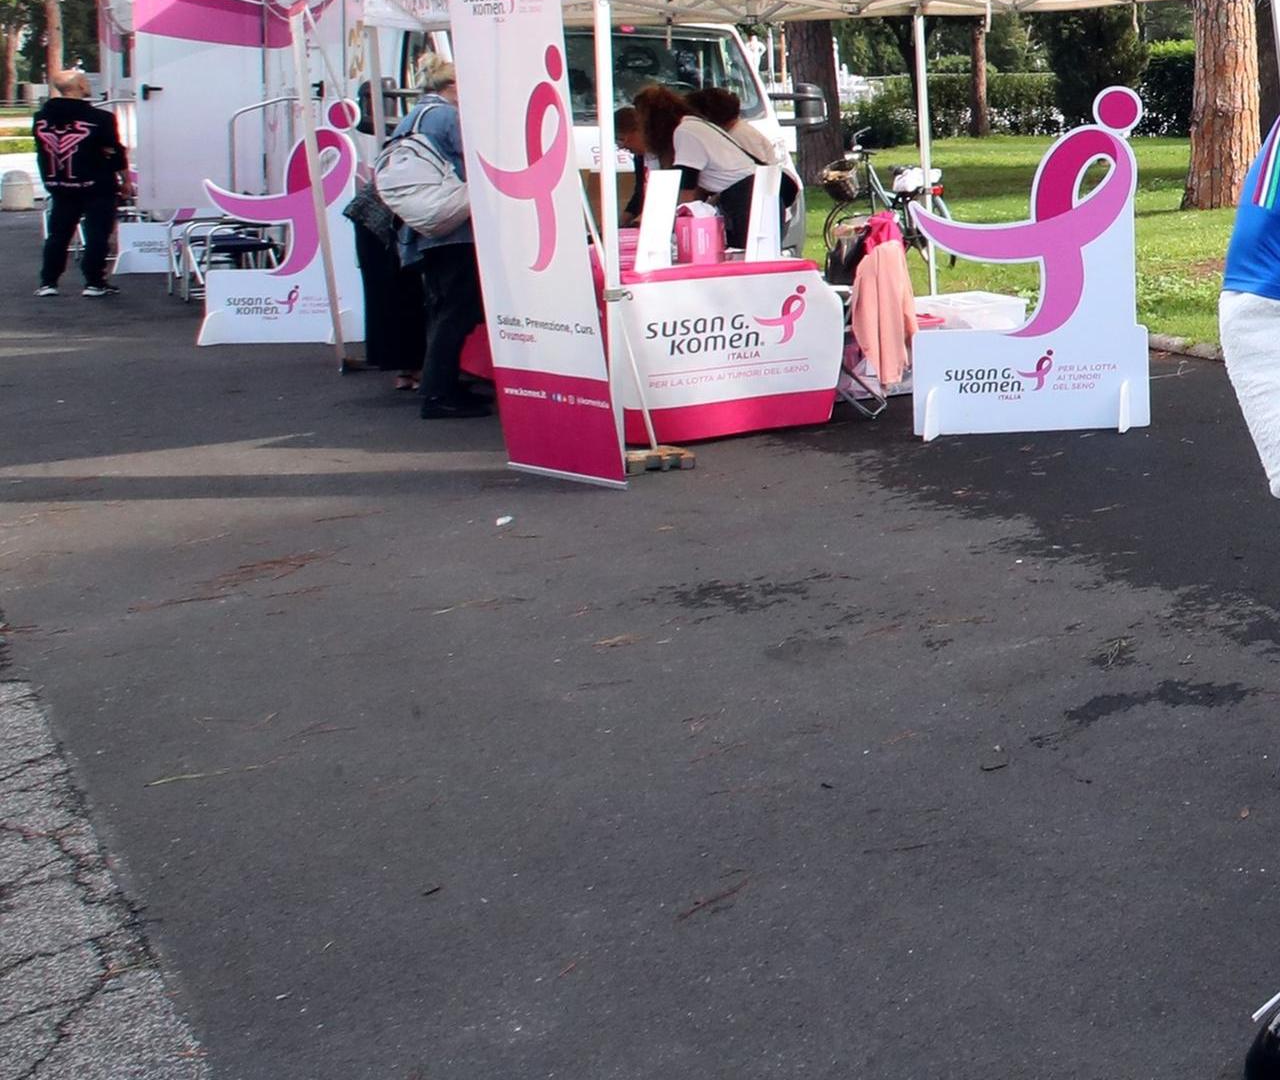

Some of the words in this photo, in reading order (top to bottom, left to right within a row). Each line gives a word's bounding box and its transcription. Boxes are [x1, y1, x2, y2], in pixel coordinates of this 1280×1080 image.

[727, 350, 761, 361] ITALIA
[1057, 364, 1075, 372] PER
[1090, 363, 1117, 371] LOTTA
